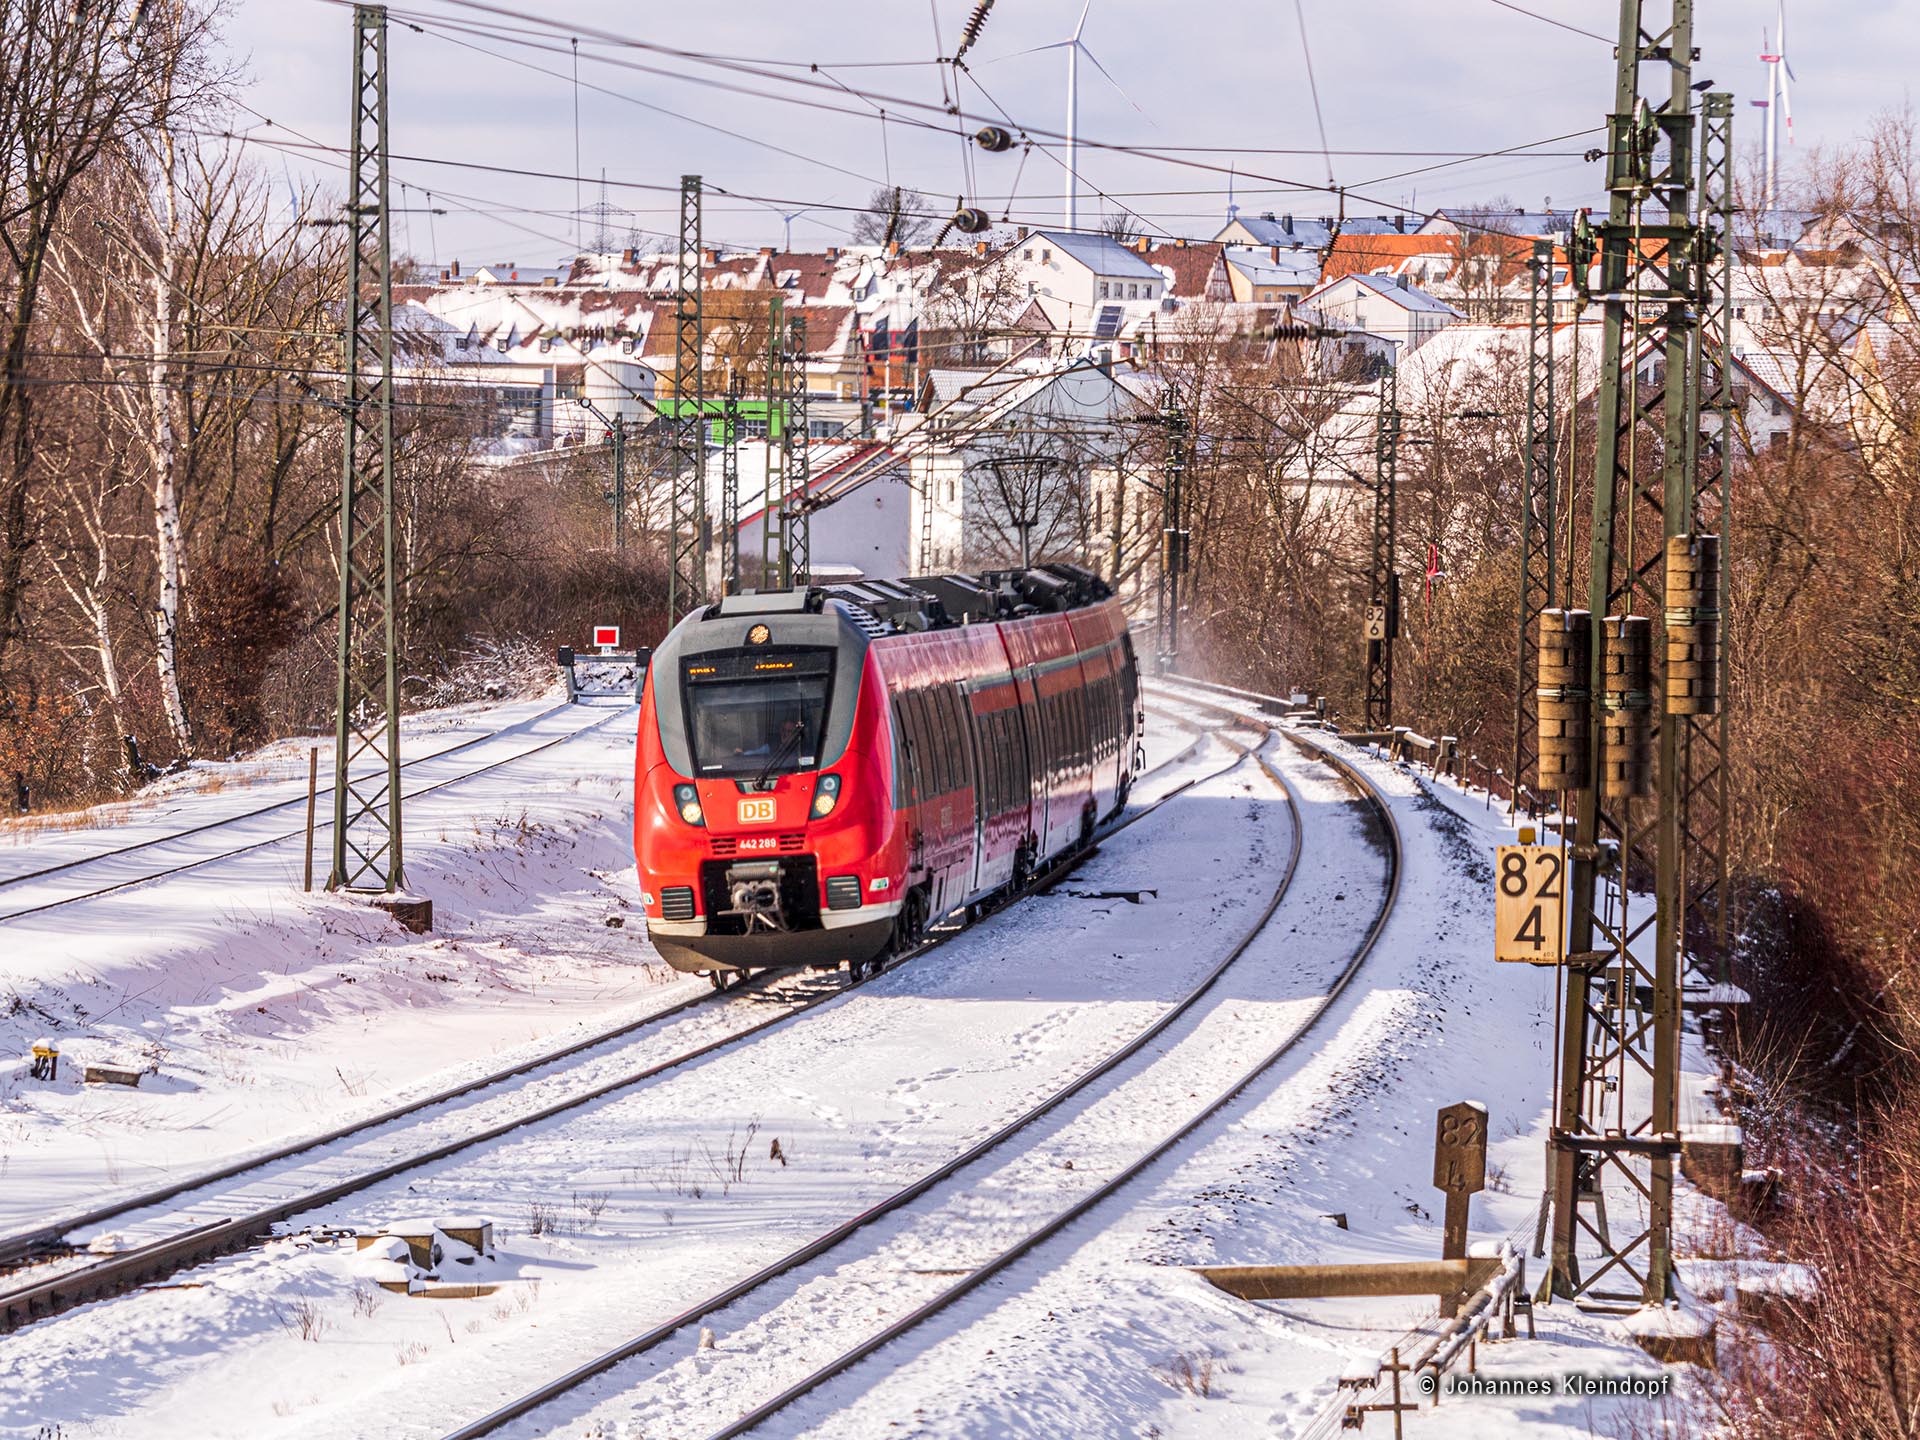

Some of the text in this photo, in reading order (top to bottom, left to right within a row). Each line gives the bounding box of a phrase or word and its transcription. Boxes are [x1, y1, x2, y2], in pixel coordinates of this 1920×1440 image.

[1366, 608, 1384, 621] 82
[1370, 622, 1379, 636] 6
[743, 803, 771, 819] DB
[740, 838, 777, 849] 442 289
[1501, 852, 1561, 898] 82
[1513, 905, 1546, 951] 4
[1440, 1114, 1481, 1148] 82
[1448, 1159, 1466, 1192] 4
